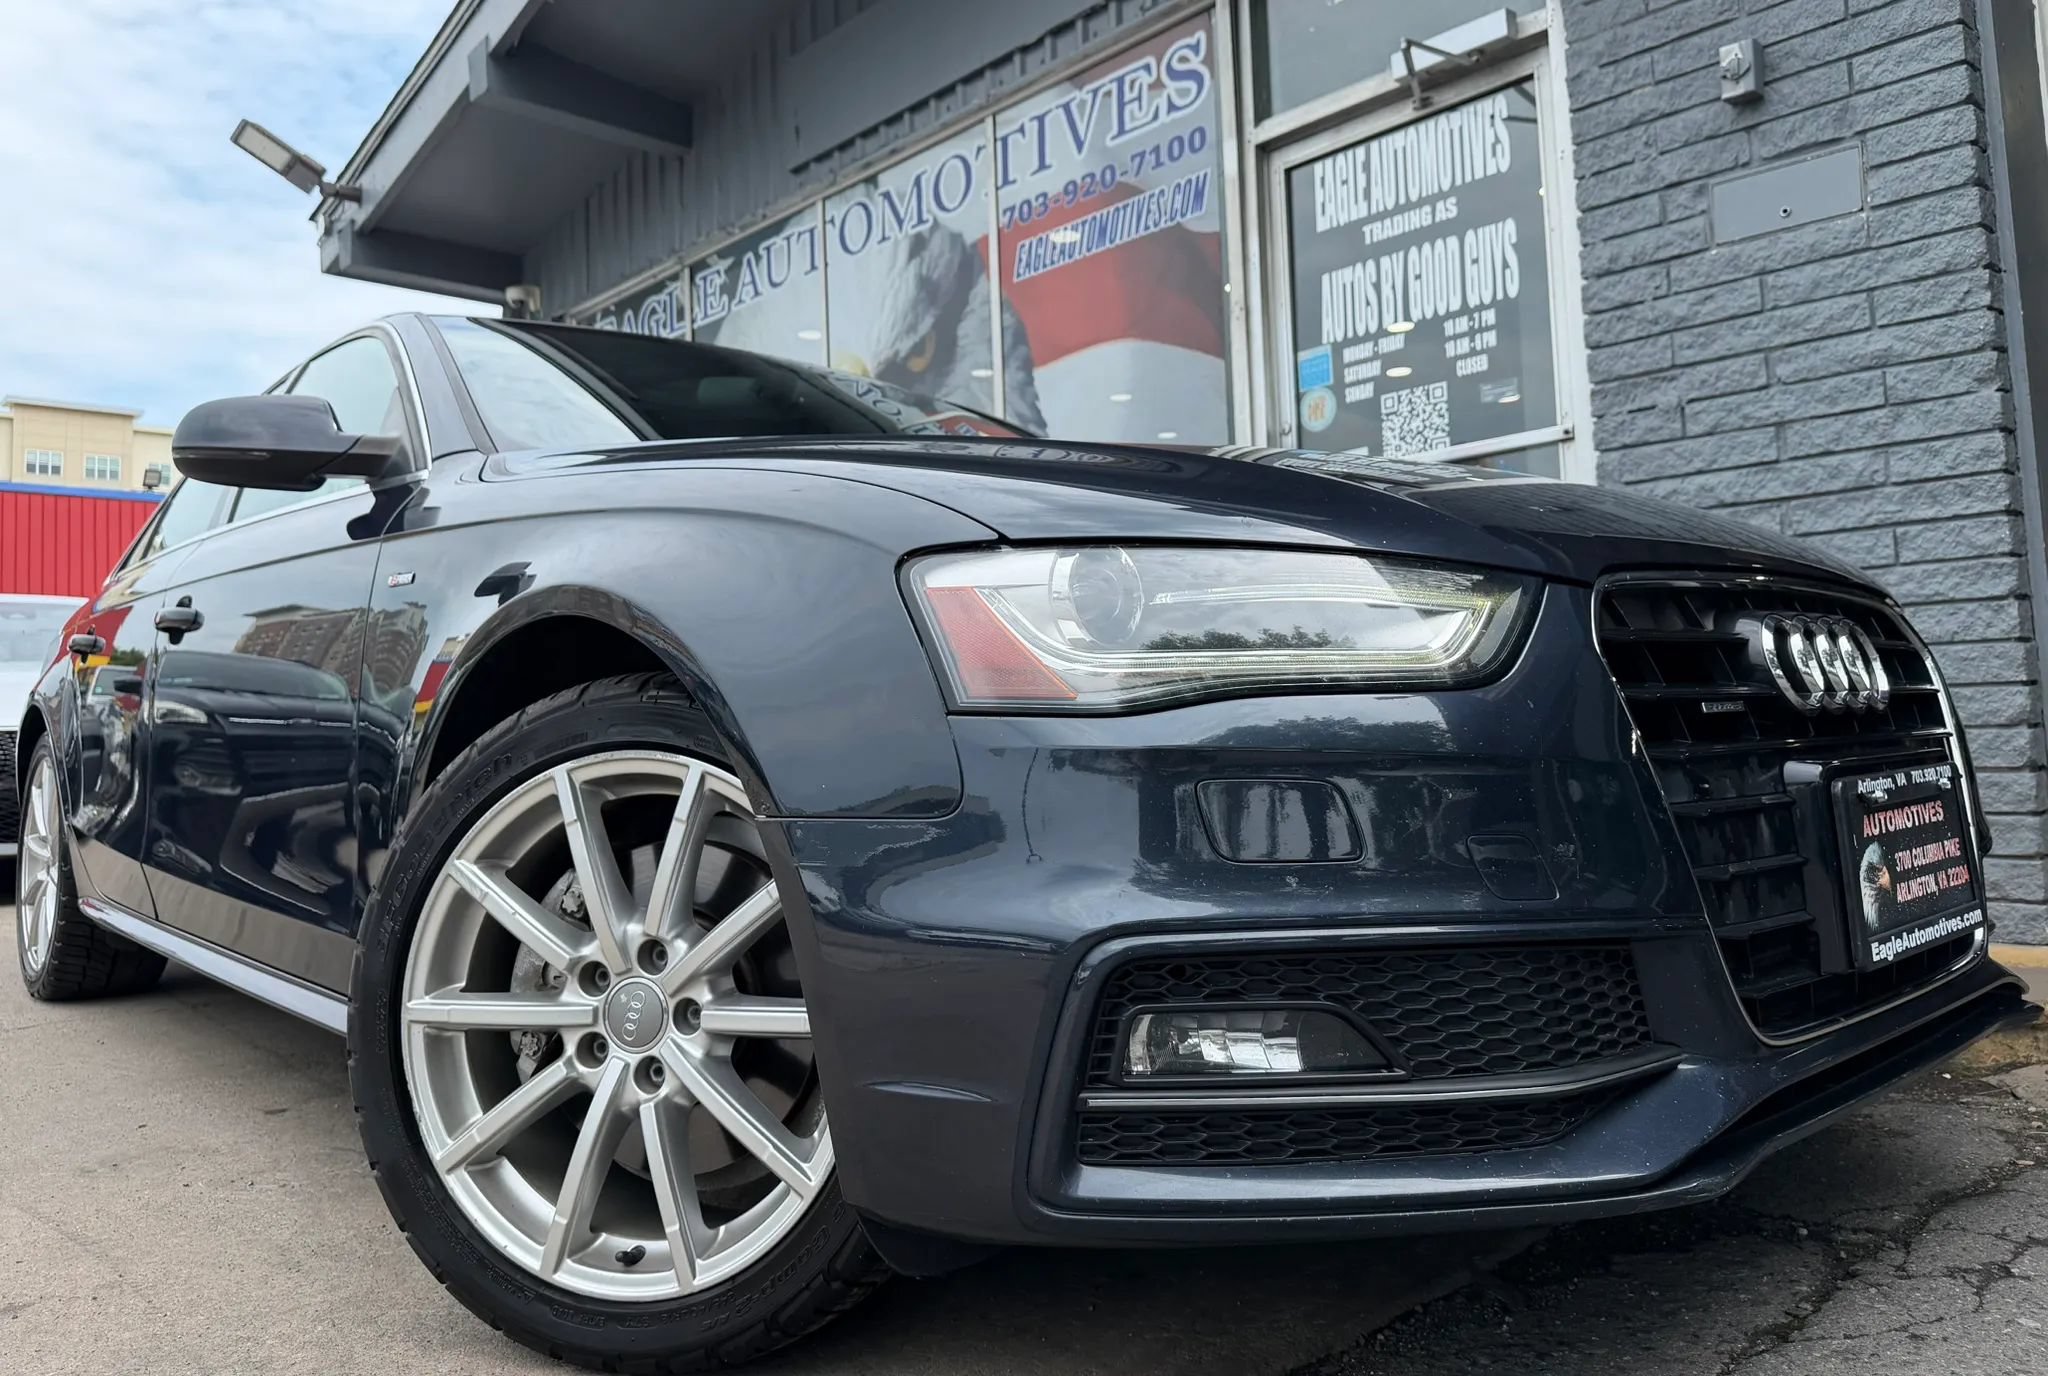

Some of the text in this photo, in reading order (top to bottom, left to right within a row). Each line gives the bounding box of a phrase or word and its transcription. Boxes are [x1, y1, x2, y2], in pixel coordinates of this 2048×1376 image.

[734, 35, 1209, 308] AUTOMOTIVES
[1003, 126, 1208, 230] 703-920-7100
[1314, 94, 1511, 232] EAGLE AUTOMOTIVES
[1015, 171, 1210, 281] EAGLEAUTOMOTIVES.COM
[1362, 196, 1458, 245] TRADING AS
[1321, 217, 1520, 344] AUTOS BY GOOD GUYS
[1443, 319, 1455, 337] 10
[1455, 314, 1469, 332] AM
[1473, 312, 1480, 329] 7
[1481, 308, 1496, 327] PM
[1444, 340, 1455, 358] 10
[1455, 336, 1470, 355] AM
[1482, 329, 1497, 349] PM
[1456, 353, 1488, 378] CLOSED
[1857, 765, 1952, 794] Arlington, VA 703.920.7100
[1863, 800, 1945, 838] AUTOMOTIVES
[1895, 838, 1961, 872] 3700 COLUMBIA PIKE
[1896, 864, 1970, 903] ARLINGTON, VA 22204
[1871, 908, 1983, 963] EagleAutomotives.com
